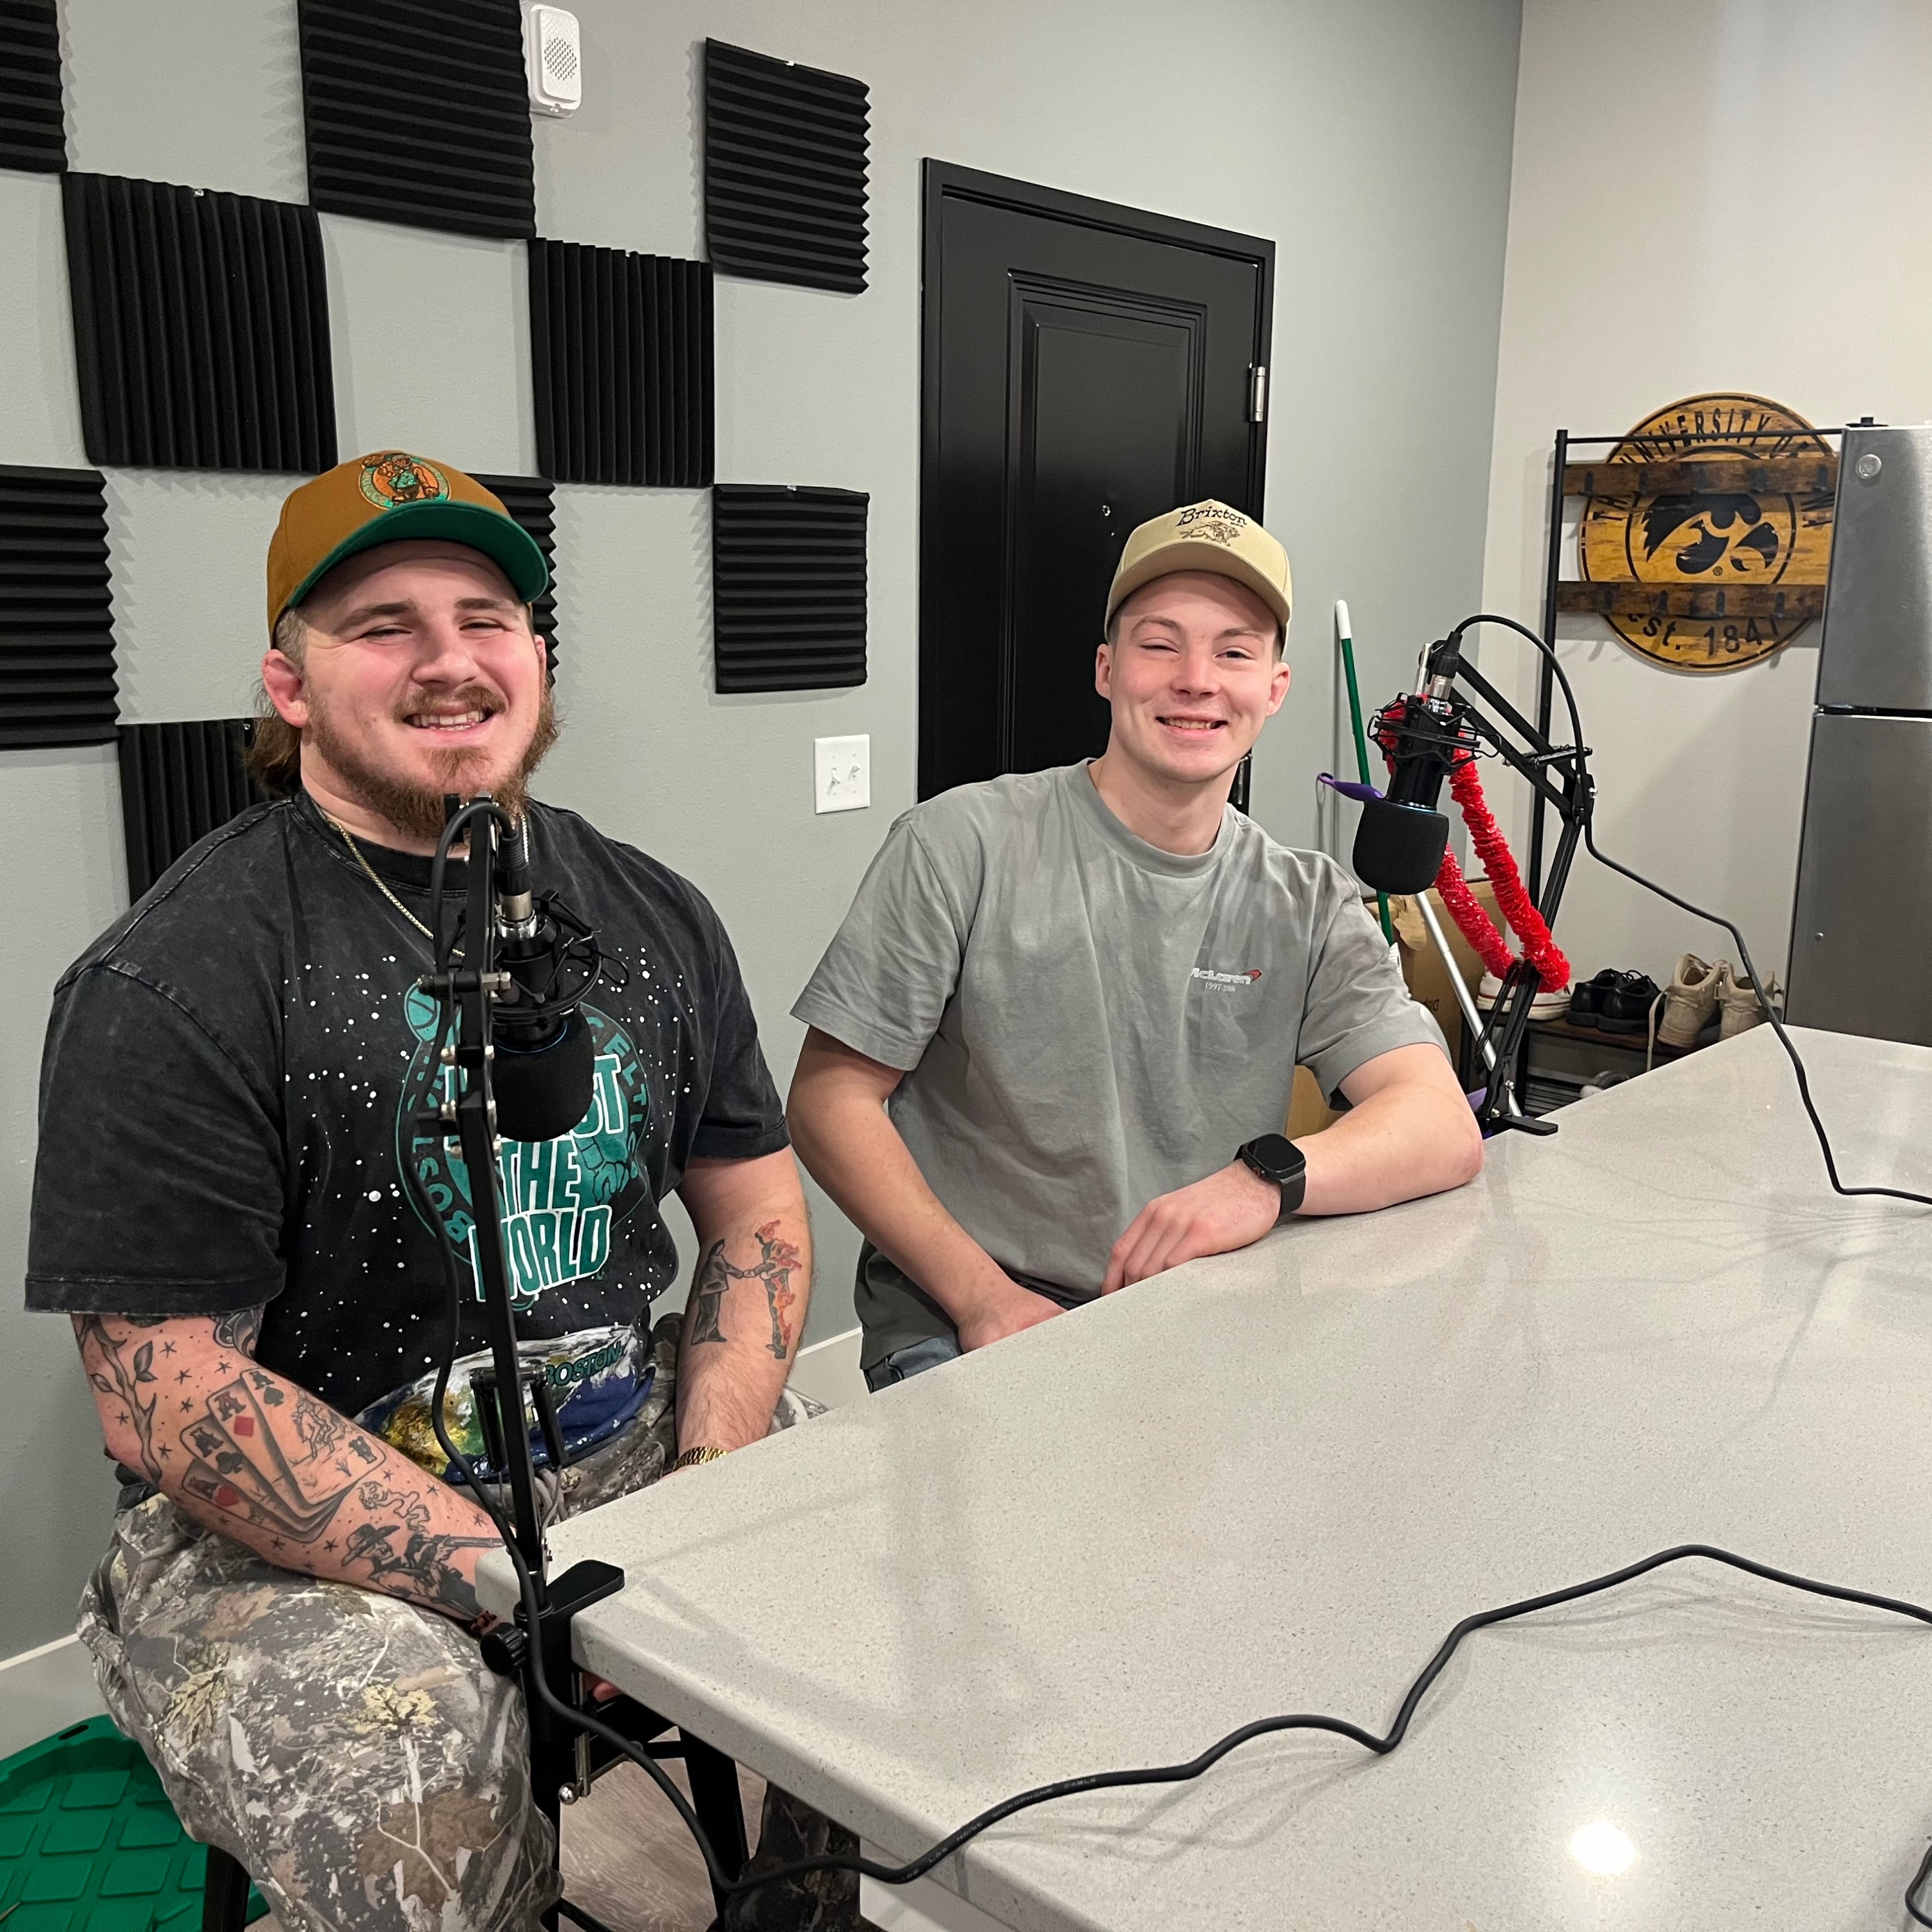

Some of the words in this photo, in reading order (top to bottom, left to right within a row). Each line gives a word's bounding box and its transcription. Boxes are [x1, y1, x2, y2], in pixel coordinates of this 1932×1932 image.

[1175, 506, 1247, 527] Brixton
[495, 1135, 582, 1217] THE
[545, 1341, 622, 1386] BOSTON
